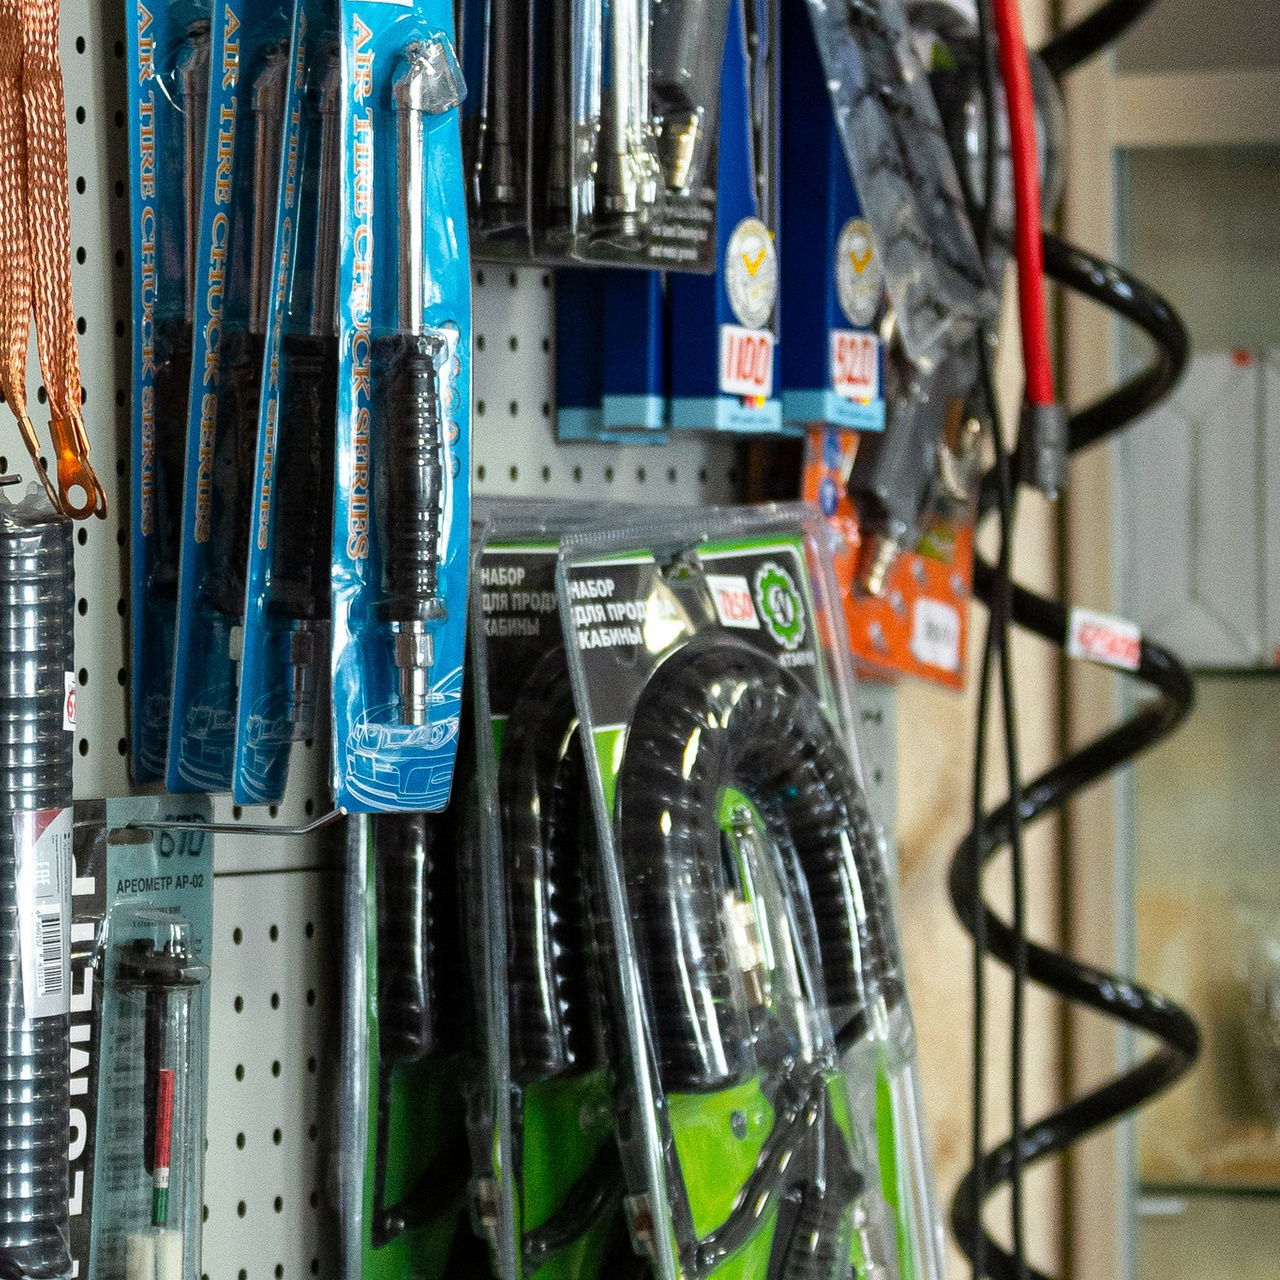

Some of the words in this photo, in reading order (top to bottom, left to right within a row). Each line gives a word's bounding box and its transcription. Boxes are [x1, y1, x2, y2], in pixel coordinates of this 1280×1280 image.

[137, 0, 154, 86] AIR
[222, 3, 241, 91] AIR
[353, 12, 375, 107] AIR
[139, 90, 156, 201] TIRE
[214, 96, 238, 206] TIRE
[352, 107, 374, 219] TIRE
[140, 206, 156, 381] CHUCK
[204, 212, 230, 387] CHUCK
[350, 221, 375, 401] CHUCK
[140, 385, 155, 537] SERIES
[193, 392, 219, 544] SERIES
[346, 406, 371, 561] SERIES
[481, 568, 526, 586] НАБОР
[482, 593, 511, 612] ДЛЯ
[570, 578, 615, 601] НАБОР
[576, 605, 606, 627] ДЛЯ
[579, 627, 644, 650] КАБИНЫ
[117, 876, 173, 894] АРЕОМЕТР
[175, 874, 205, 890] АР-02
